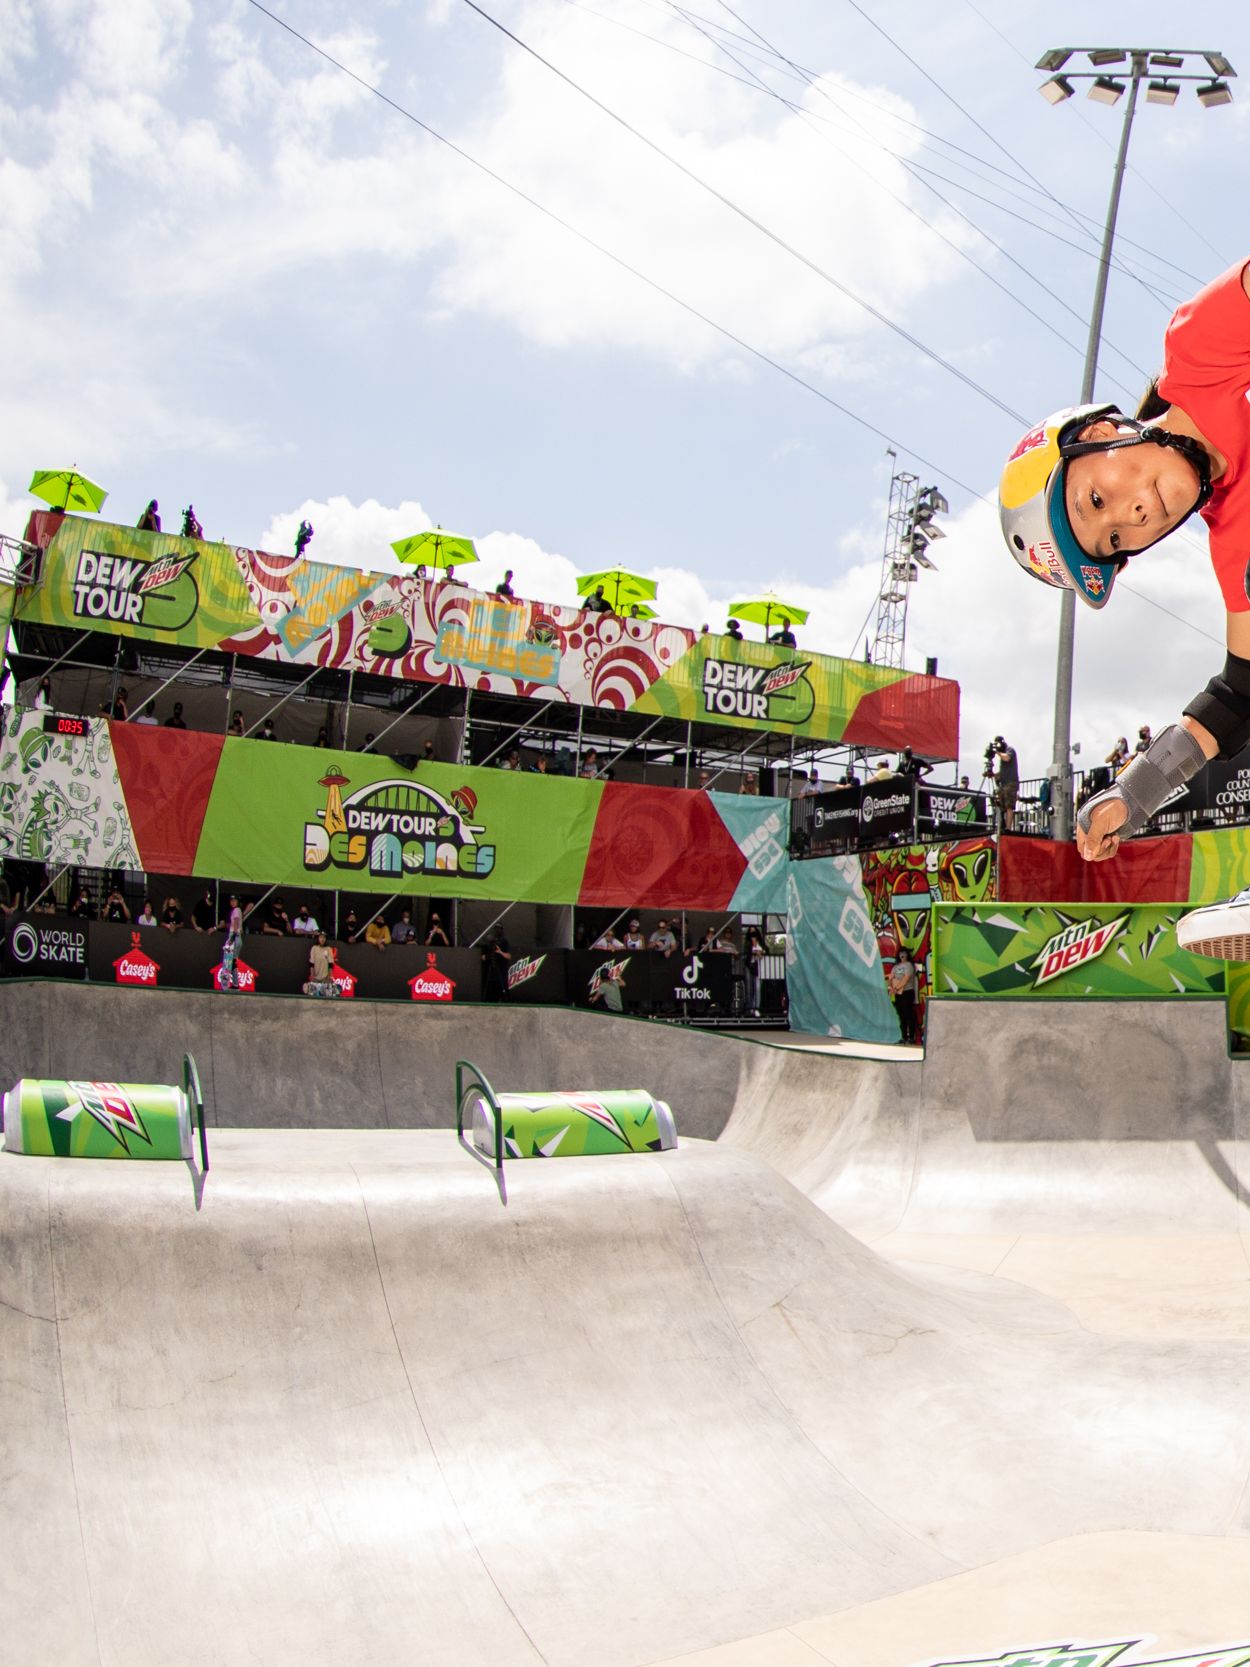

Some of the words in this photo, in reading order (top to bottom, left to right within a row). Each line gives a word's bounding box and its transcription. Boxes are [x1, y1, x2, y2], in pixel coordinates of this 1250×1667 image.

[77, 552, 145, 589] DEW
[75, 584, 143, 623] TOUR
[705, 659, 765, 691] DEW
[704, 685, 768, 719] TOUR
[873, 794, 910, 809] GreenState
[930, 795, 955, 812] DEW
[304, 824, 367, 865] DES
[371, 832, 495, 874] MOINES
[40, 929, 85, 946] WORLD
[40, 944, 85, 963] SKATE
[119, 960, 155, 981] Casey's
[414, 978, 450, 997] Casey's
[674, 987, 711, 999] TikTok
